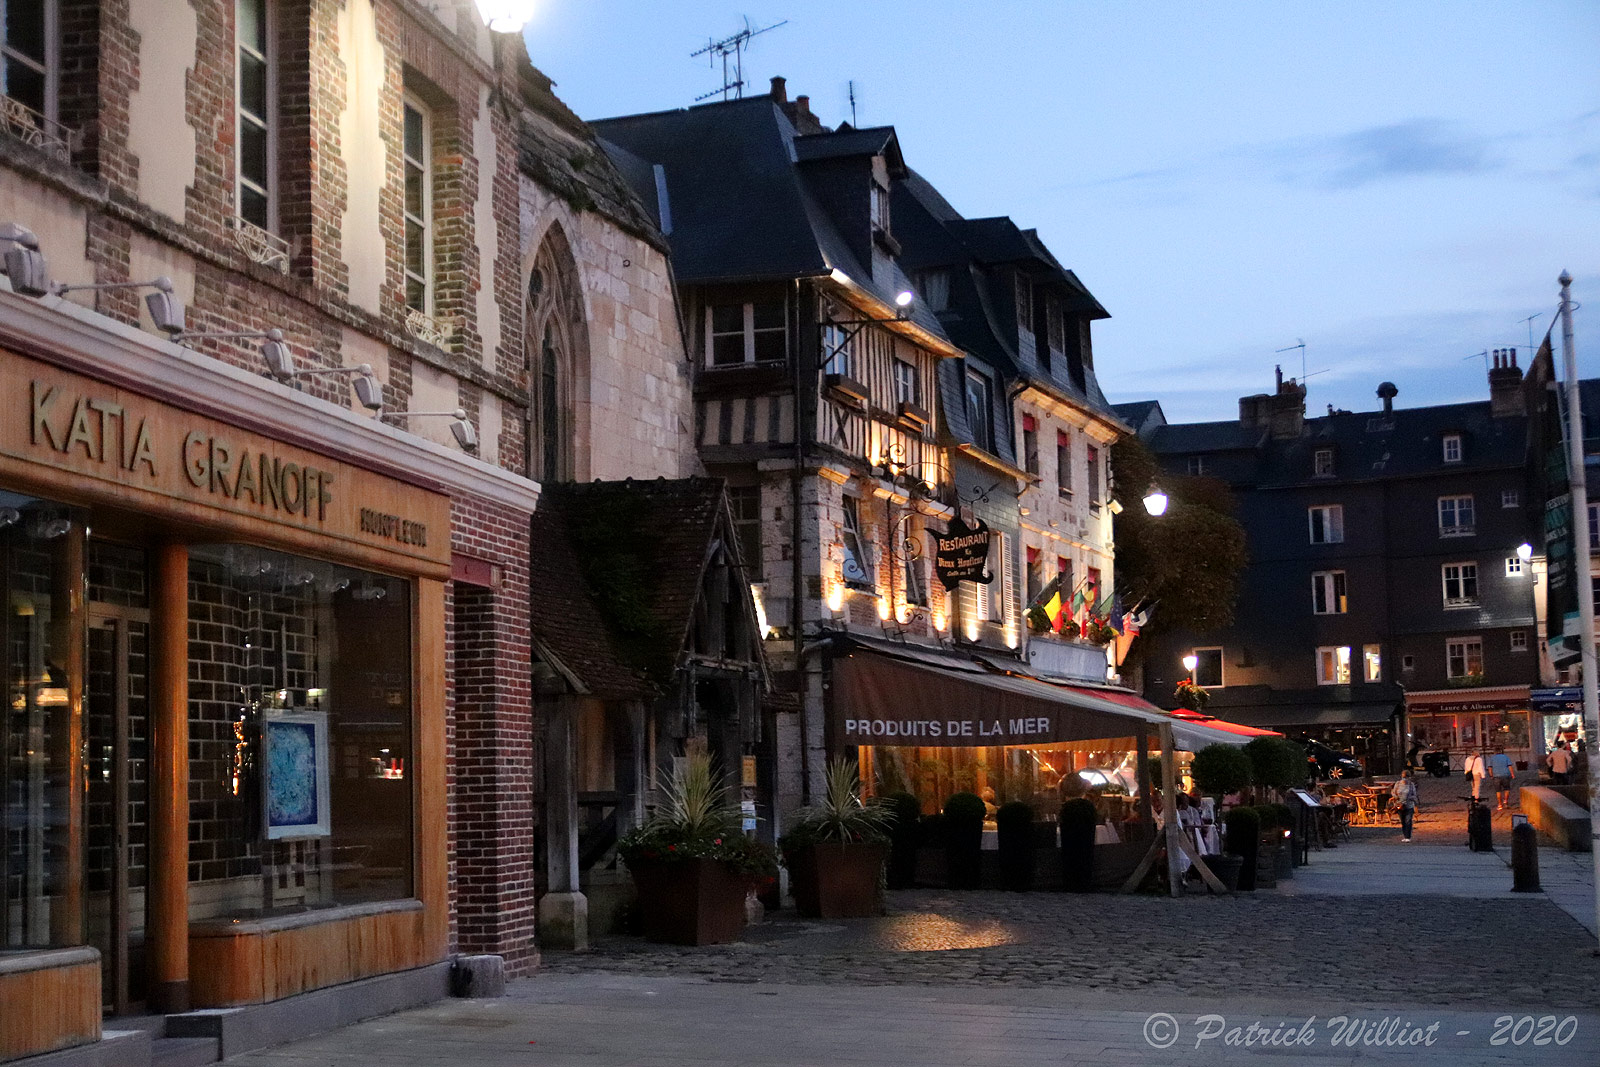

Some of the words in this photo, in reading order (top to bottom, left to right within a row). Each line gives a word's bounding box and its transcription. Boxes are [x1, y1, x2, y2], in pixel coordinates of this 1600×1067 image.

[30, 380, 157, 477] KATIA
[182, 430, 334, 521] GRANOFF
[360, 507, 427, 548] HONFLEUR
[939, 531, 988, 551] RESTAURANT
[937, 556, 955, 568] Vieux
[957, 556, 984, 568] Honfleur
[845, 719, 942, 737] PRODUITS
[947, 720, 973, 736] DE
[979, 720, 1004, 736] LA
[1009, 717, 1050, 735] MER
